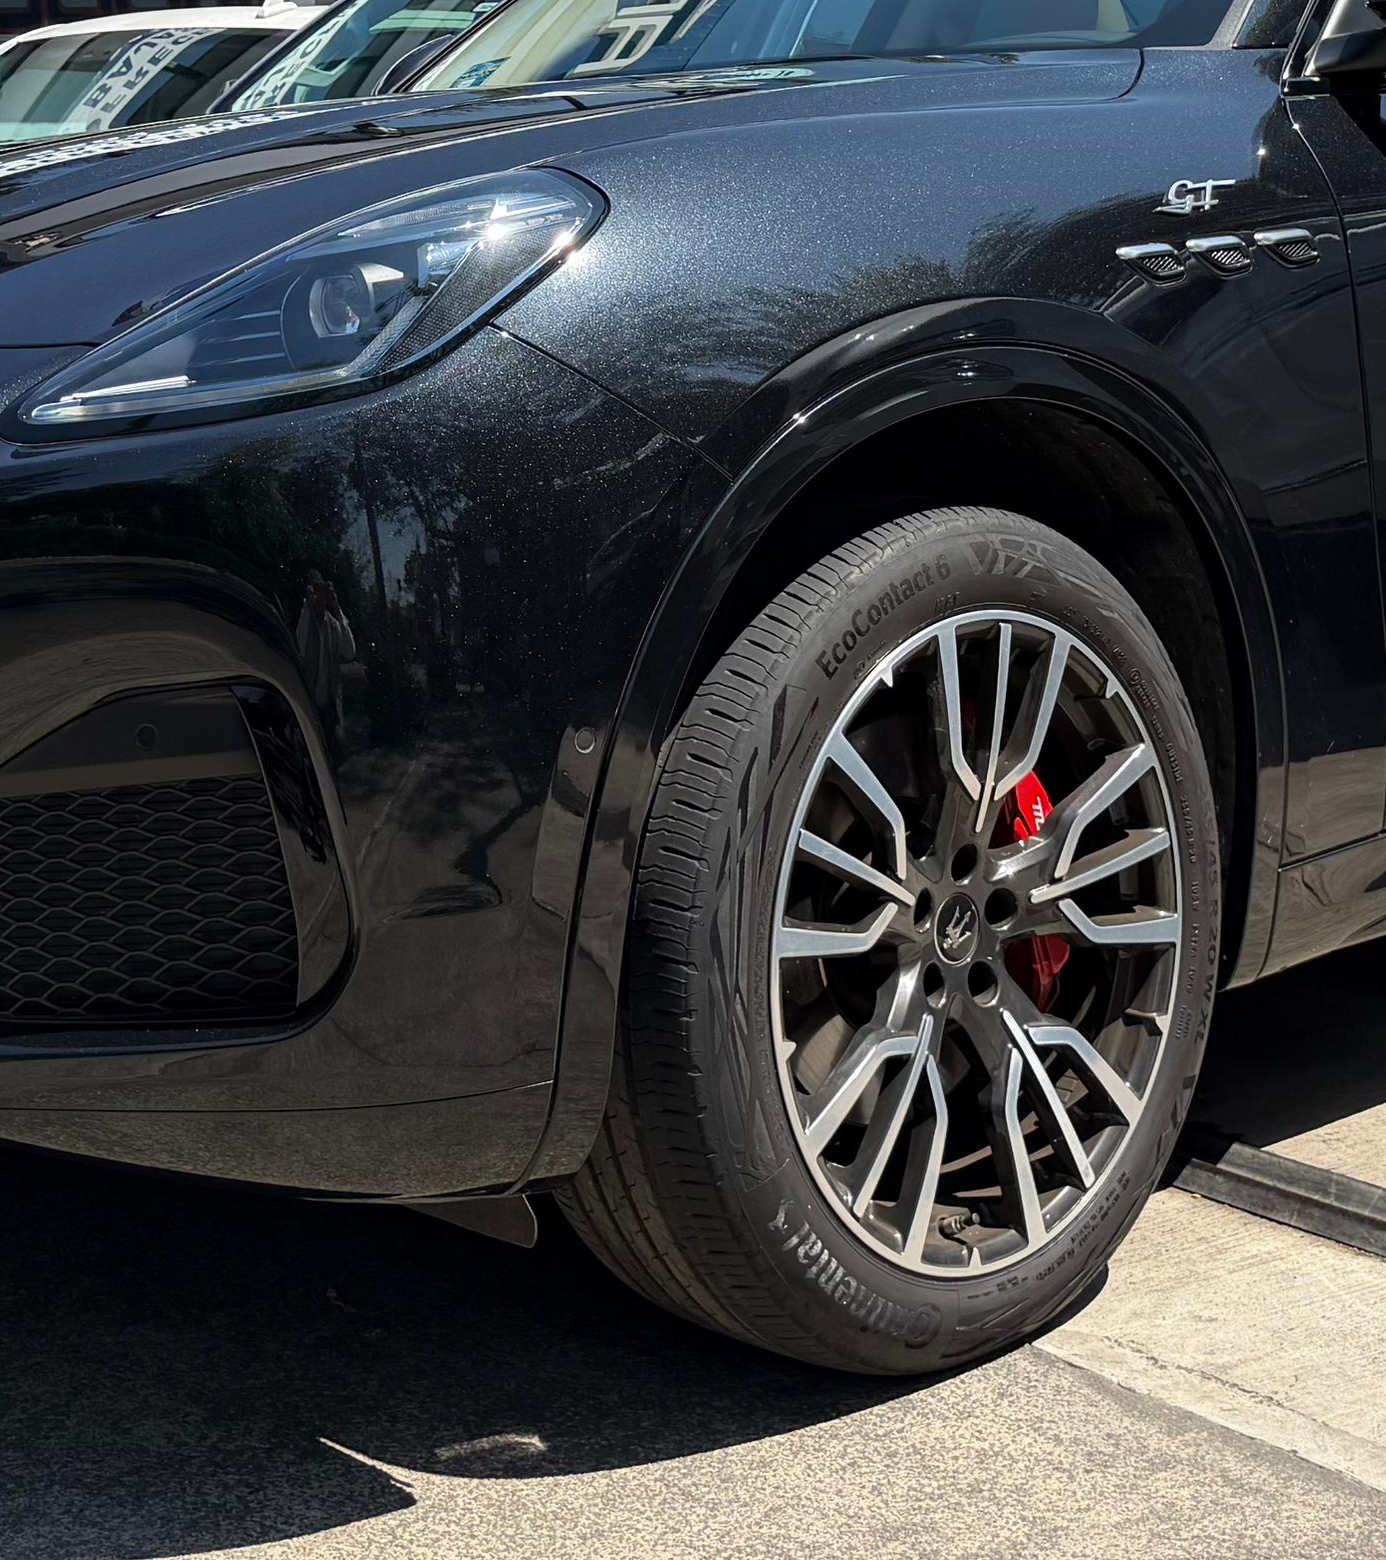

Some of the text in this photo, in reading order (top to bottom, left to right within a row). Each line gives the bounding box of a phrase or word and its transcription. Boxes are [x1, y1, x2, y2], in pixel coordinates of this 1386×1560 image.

[1153, 178, 1236, 215] GT
[815, 563, 935, 680] EcoContact
[934, 553, 953, 582] 6
